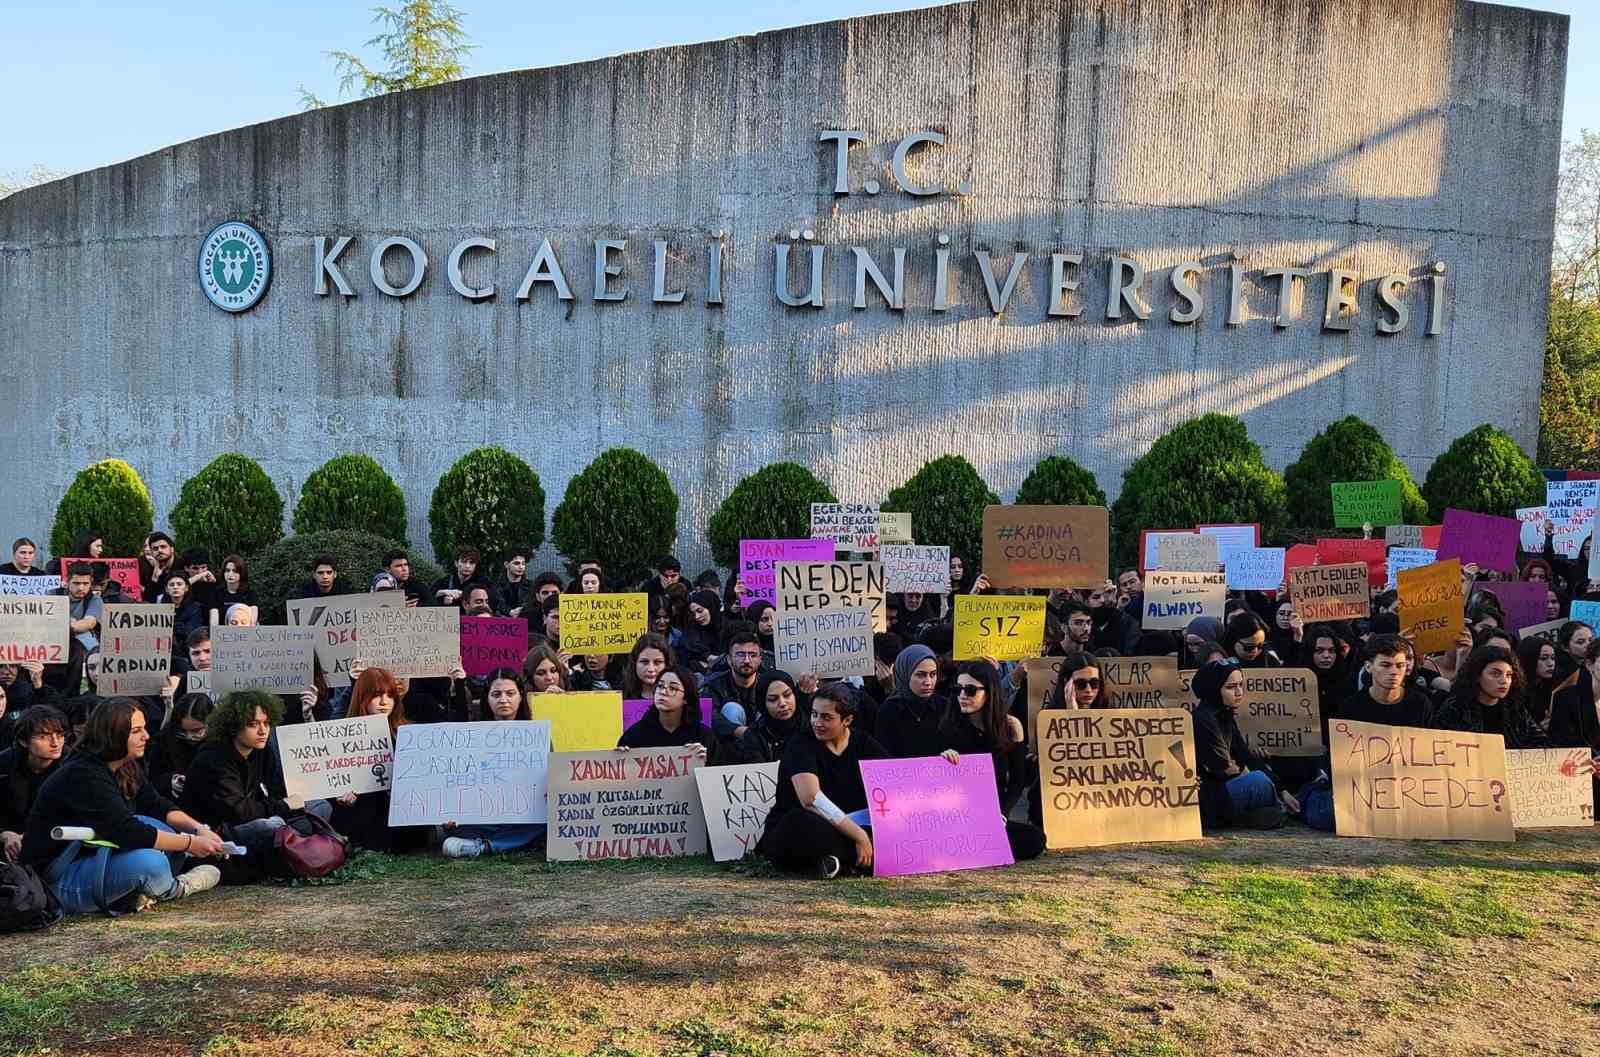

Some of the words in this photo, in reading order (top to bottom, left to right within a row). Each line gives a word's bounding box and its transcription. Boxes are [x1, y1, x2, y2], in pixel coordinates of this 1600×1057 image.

[820, 130, 971, 196] T.C.
[314, 229, 726, 304] KOCAELİ
[774, 229, 1447, 337] ÜNİVERSİTESİ
[997, 524, 1073, 541] #KADINA
[780, 563, 885, 594] NEDEN
[1152, 576, 1178, 585] NOT
[1181, 576, 1201, 585] ALL
[1202, 576, 1226, 586] MEN
[1303, 582, 1362, 599] KADINLAR
[109, 611, 173, 629] KADININ
[1147, 601, 1204, 617] ALWAYS
[588, 622, 607, 632] BEN
[609, 622, 622, 631] DE
[777, 618, 808, 637] HEM
[811, 612, 867, 633] YASTAYIZ
[778, 642, 808, 665] HEM
[102, 657, 167, 674] KADINA
[1246, 676, 1307, 693] BENSEM
[309, 721, 369, 740] HİKAYESİ
[1045, 716, 1104, 739] ARTIK
[1109, 717, 1185, 738] SADECE
[289, 744, 331, 760] YARIM
[341, 738, 390, 754] KALAN
[398, 730, 415, 753] 2
[501, 726, 548, 750] KADIN
[1047, 738, 1146, 763] GECELERİ
[1348, 735, 1480, 769] ADALET
[570, 758, 627, 781] KADINI
[633, 754, 693, 780] YAŞAT
[1050, 759, 1166, 788] SAKLAMBAÇ
[327, 773, 352, 788] İÇİN
[557, 792, 592, 807] KADIN
[597, 788, 664, 804] KUTSALDIR
[1053, 784, 1200, 811] OYNAMIYORUZ
[1351, 775, 1506, 812] NEREDE?
[557, 808, 594, 822] KADIN
[601, 801, 691, 818] ÖZGÜRLÜKTÜR
[722, 805, 769, 830] KAD
[557, 825, 601, 838] KADIN
[612, 820, 688, 835] TOPLUMDUR
